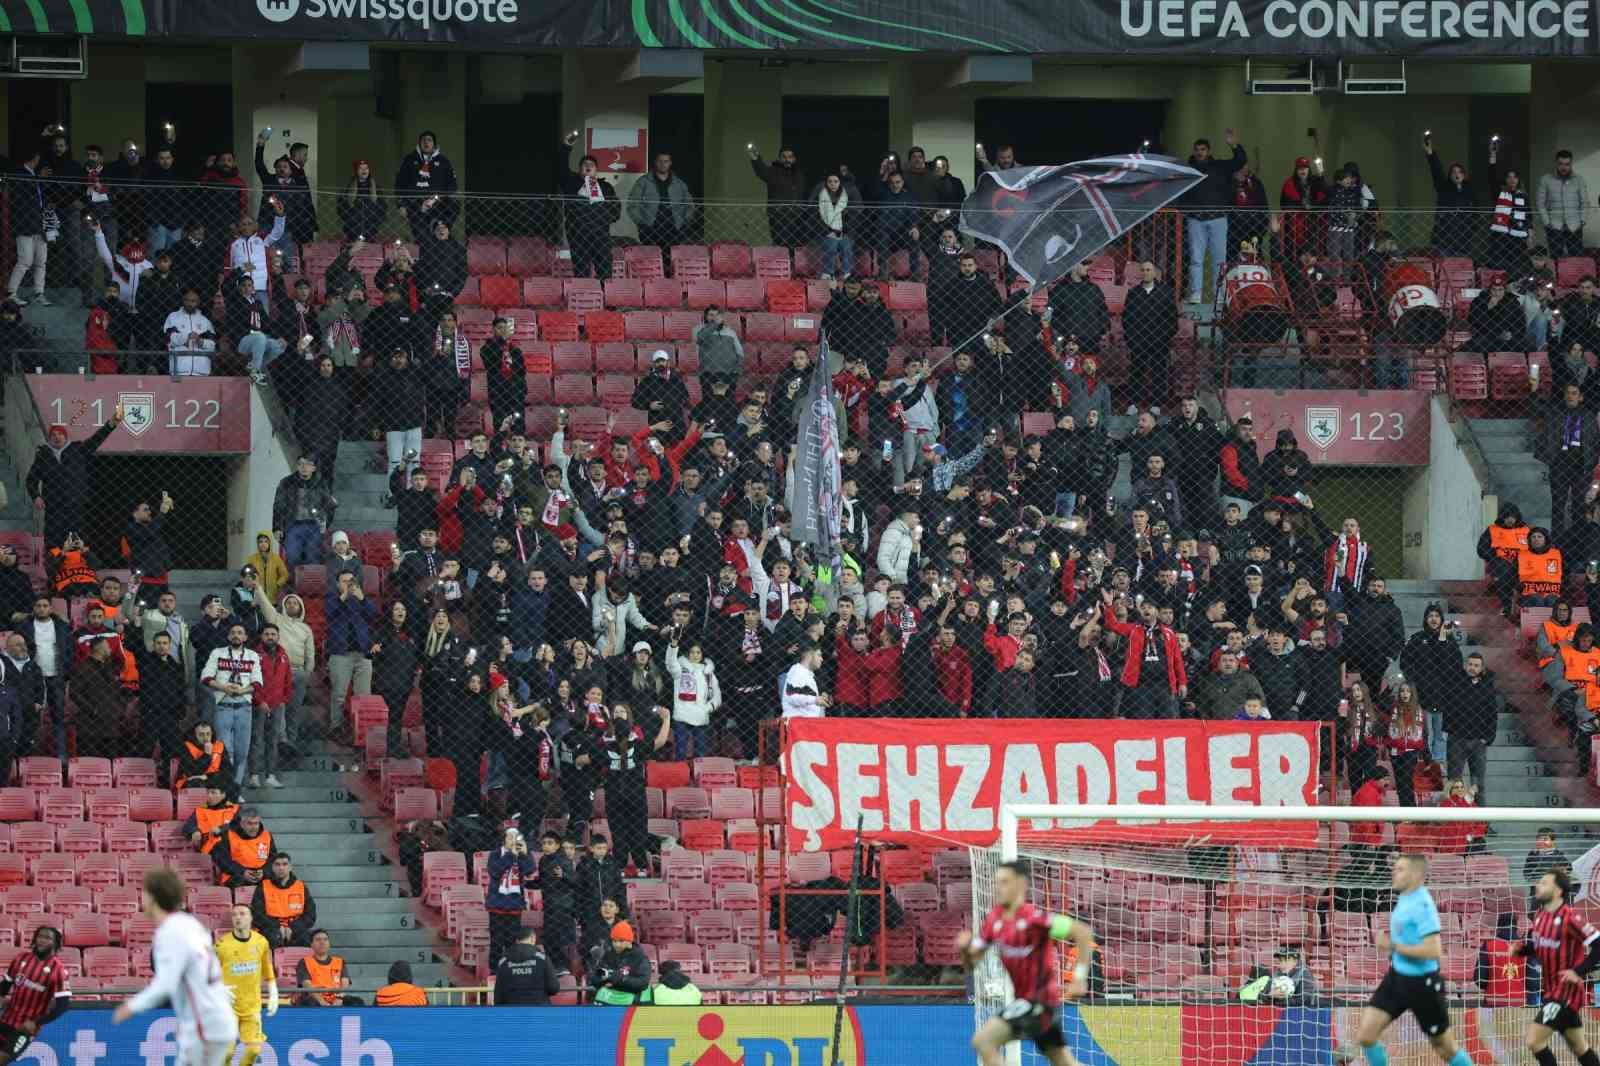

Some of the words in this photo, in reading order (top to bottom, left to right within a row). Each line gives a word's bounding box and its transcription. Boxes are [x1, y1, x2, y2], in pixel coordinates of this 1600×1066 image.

[305, 0, 518, 30] Swissquote
[1120, 0, 1250, 39] UEFA
[1263, 0, 1589, 38] CONFERENCE
[164, 399, 221, 428] 122
[1350, 411, 1404, 441] 123
[329, 790, 344, 801] 10
[791, 733, 1311, 852] ŞEHZADELER
[1545, 794, 1560, 807] 10
[367, 852, 376, 864] 8
[385, 883, 393, 895] 7
[400, 915, 408, 928] 6
[418, 951, 425, 964] 5
